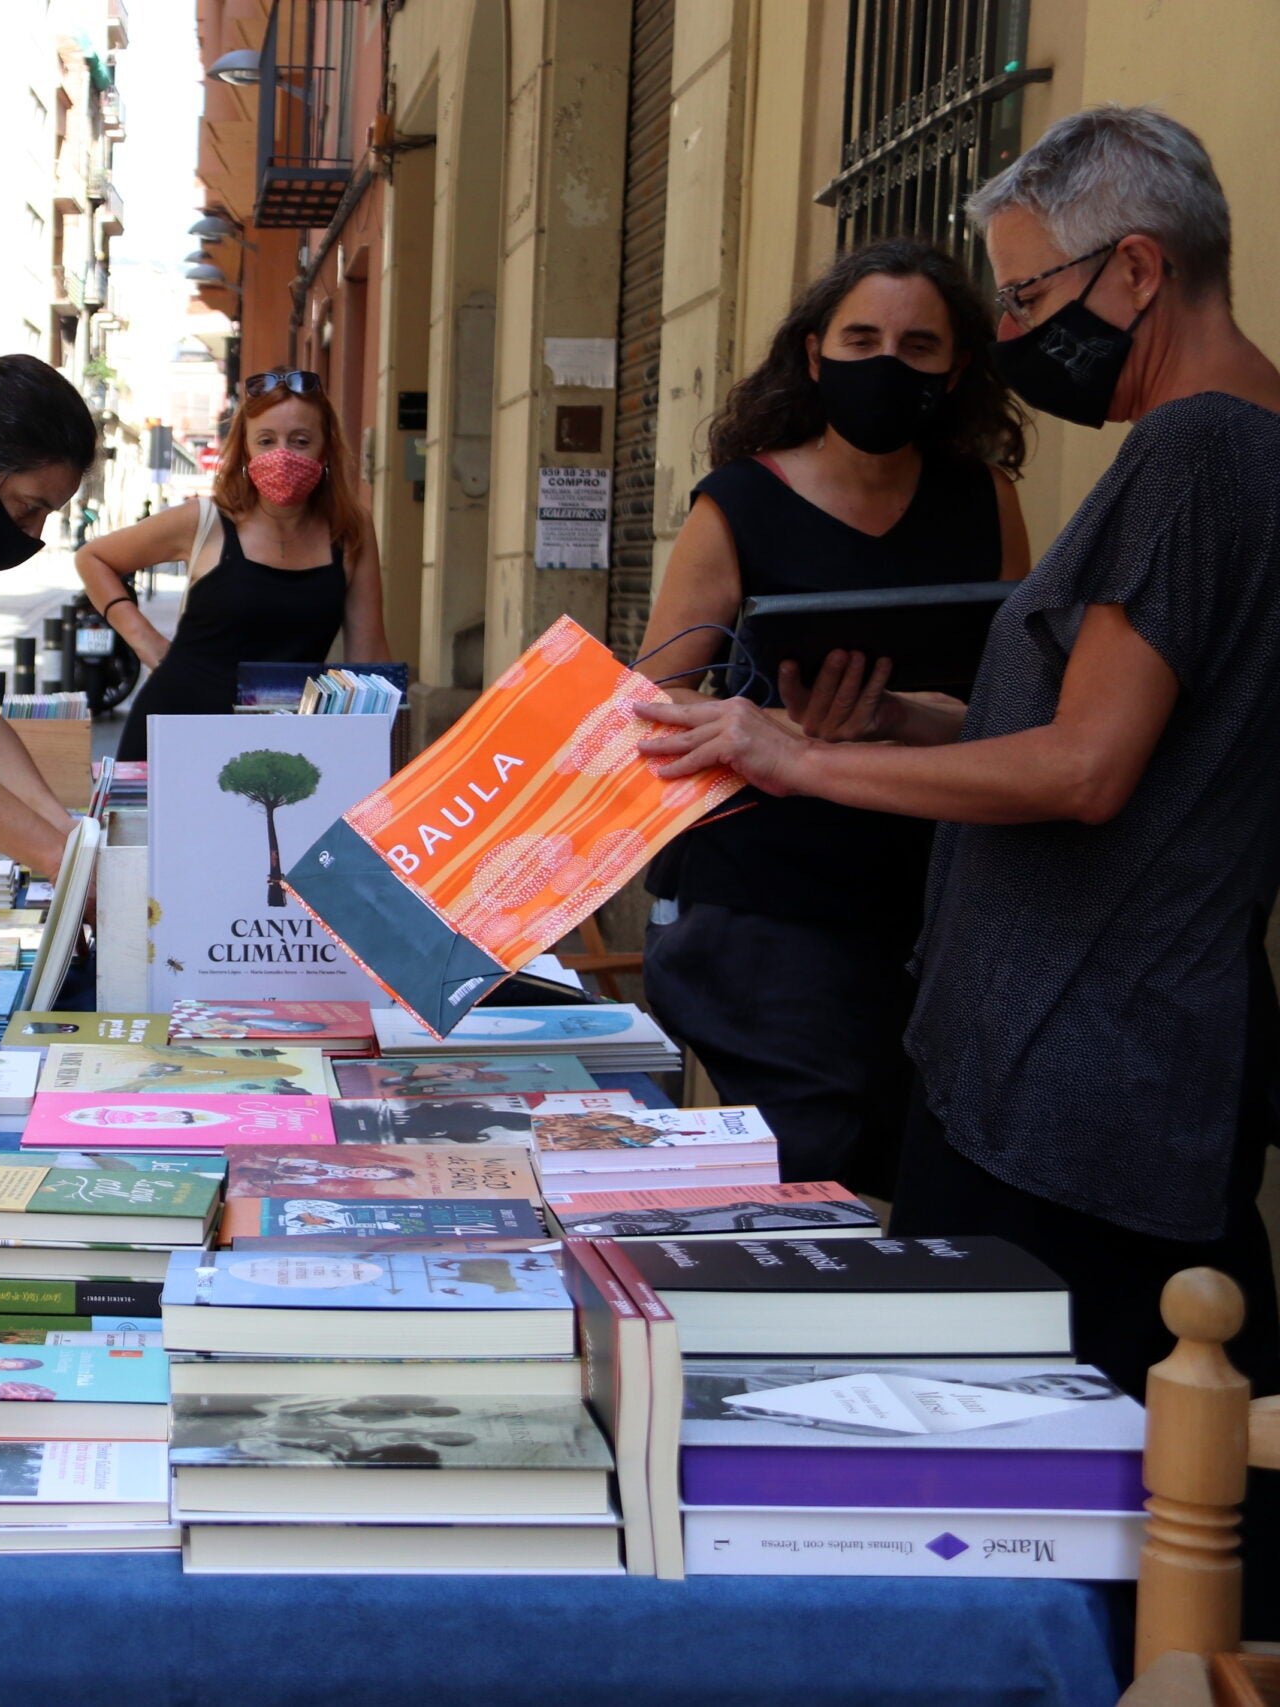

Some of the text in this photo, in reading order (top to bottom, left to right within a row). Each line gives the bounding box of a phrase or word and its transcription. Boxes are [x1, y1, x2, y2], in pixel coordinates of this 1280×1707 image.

[548, 477, 600, 487] COMPRO
[387, 753, 524, 875] BAULA
[231, 919, 313, 938] CANVI
[208, 939, 337, 963] CLIMÀTIC
[720, 1110, 749, 1135] Dunes
[432, 1222, 499, 1235] 14
[911, 1390, 957, 1417] Marsé
[949, 1393, 987, 1414] Juan
[760, 1540, 914, 1556] Últimas tardes con Teresa
[982, 1537, 1056, 1563] Marsé
